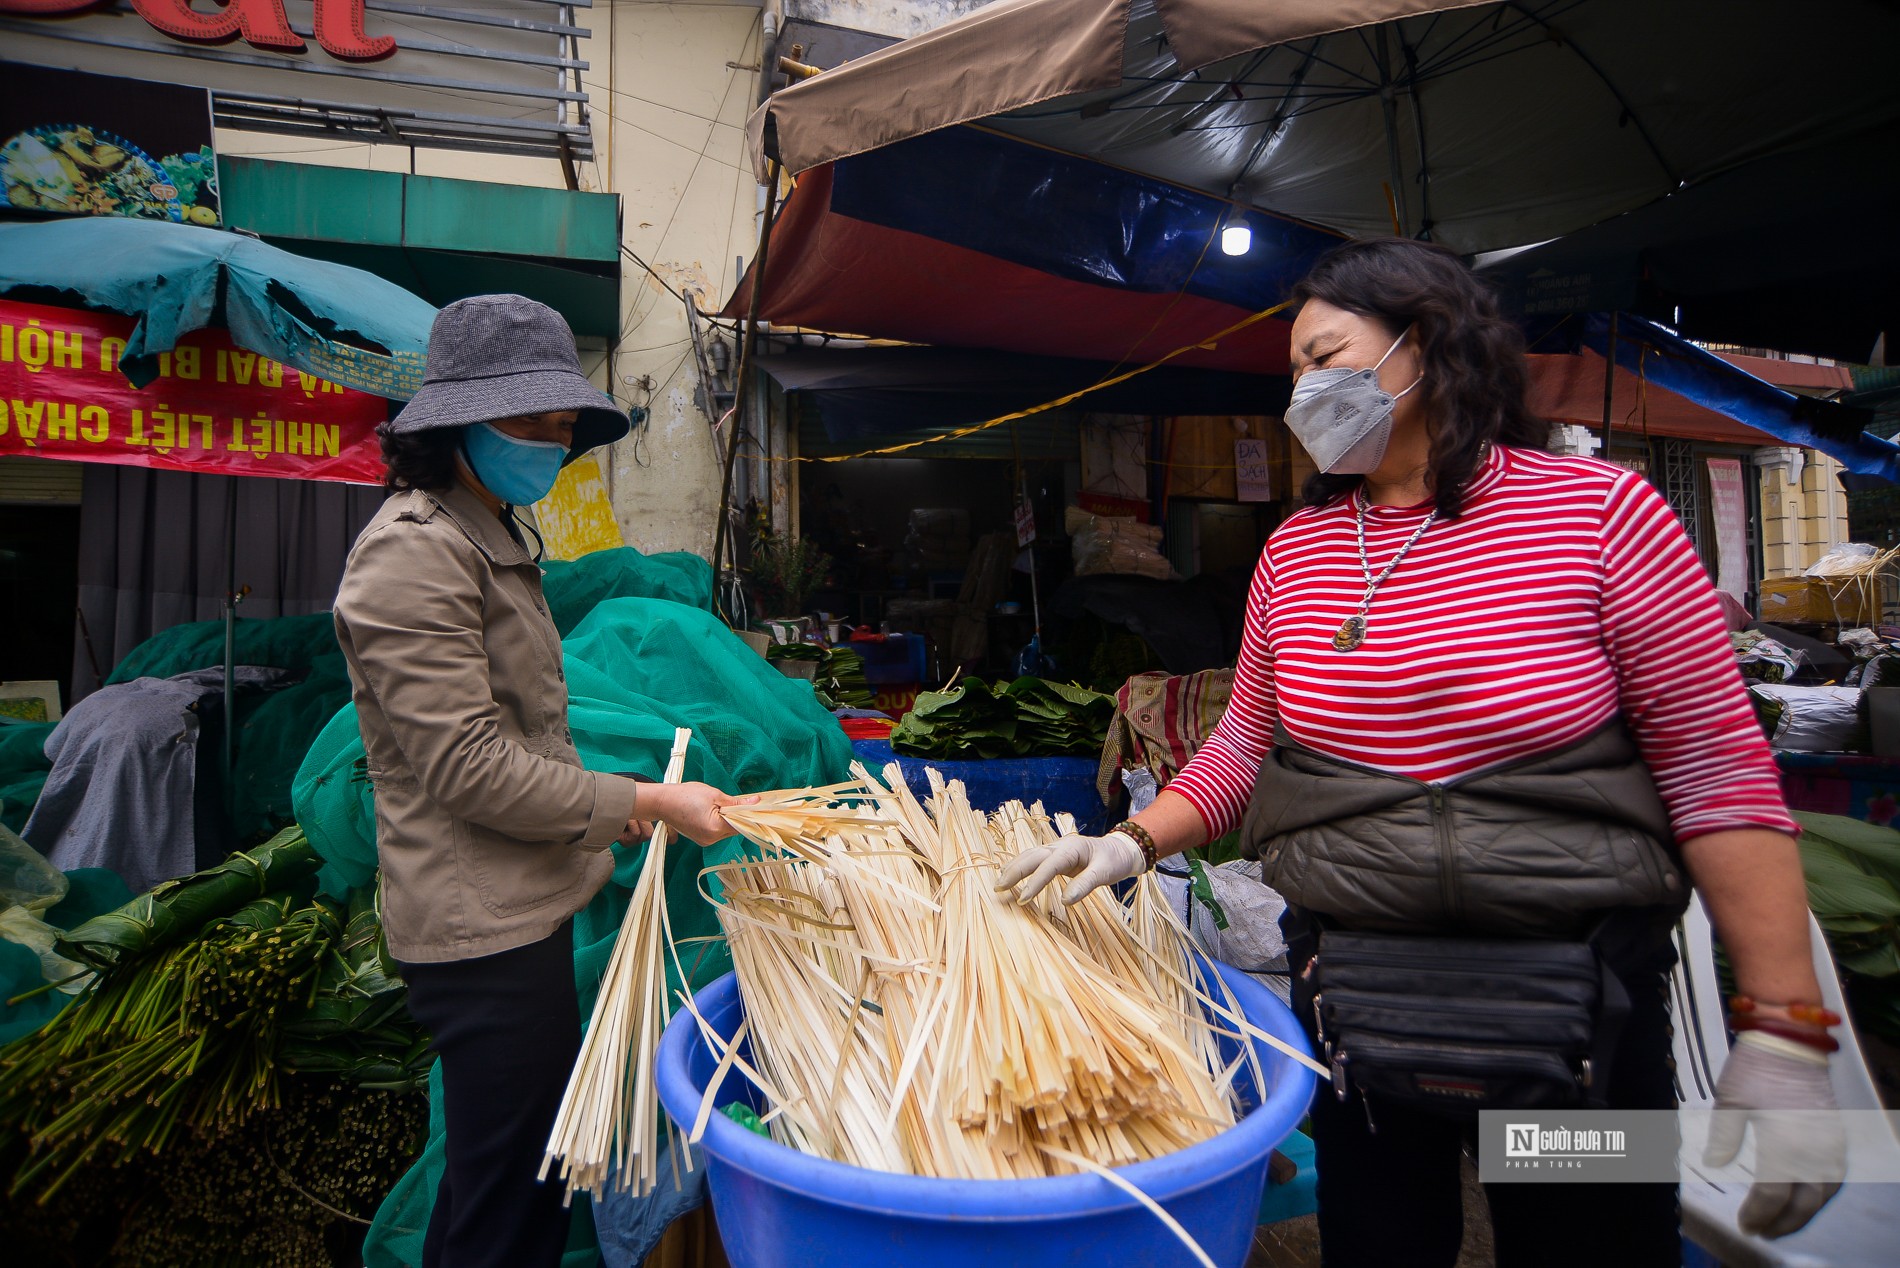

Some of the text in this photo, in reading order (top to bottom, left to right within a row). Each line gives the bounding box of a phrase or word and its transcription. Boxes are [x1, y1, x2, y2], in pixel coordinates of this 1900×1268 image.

[0, 319, 83, 373] HỘI
[101, 337, 200, 389] BIU
[216, 346, 284, 388] ĐẠI
[125, 403, 213, 455] LIỆT
[227, 411, 341, 460] NHIỆT
